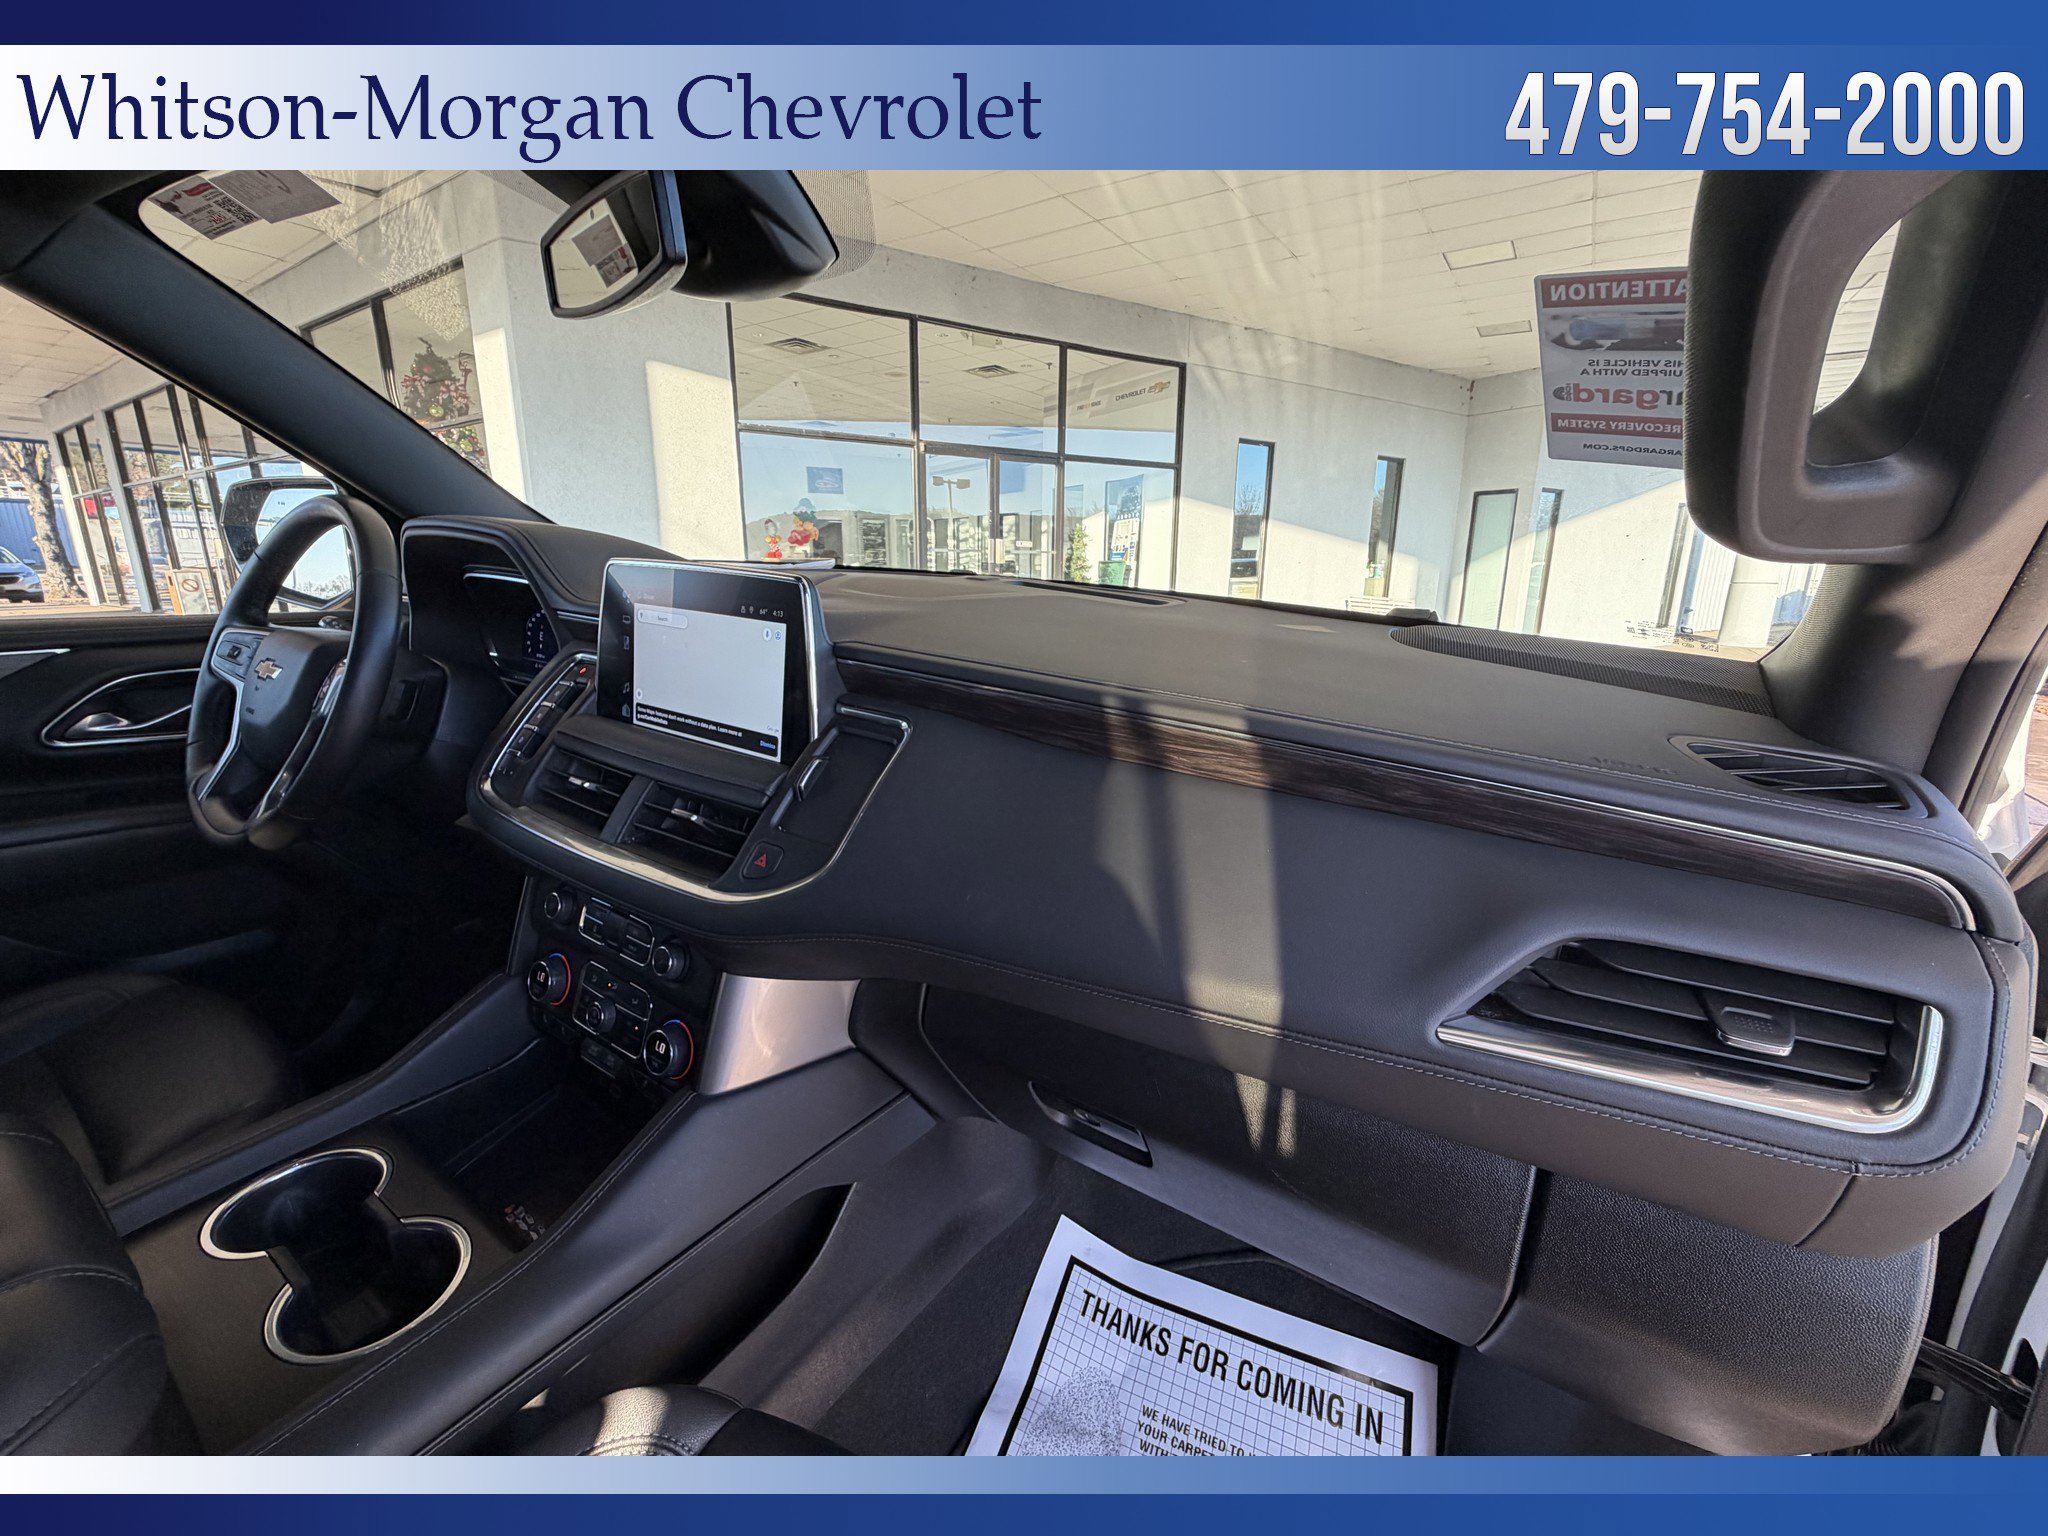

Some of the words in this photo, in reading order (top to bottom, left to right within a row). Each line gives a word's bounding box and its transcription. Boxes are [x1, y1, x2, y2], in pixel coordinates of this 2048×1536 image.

[1115, 388, 1147, 401] CHEVROLET
[1079, 1288, 1172, 1357] THANKS
[1177, 1336, 1230, 1382] FOR
[1237, 1358, 1346, 1429] COMING
[1355, 1403, 1385, 1445] IN
[1137, 1419, 1169, 1444] YOUR
[1142, 1405, 1160, 1422] WE
[1161, 1414, 1191, 1436] HAVE
[1193, 1428, 1227, 1453] TRIED
[1230, 1444, 1245, 1456] TO
[1139, 1439, 1169, 1456] WITH
